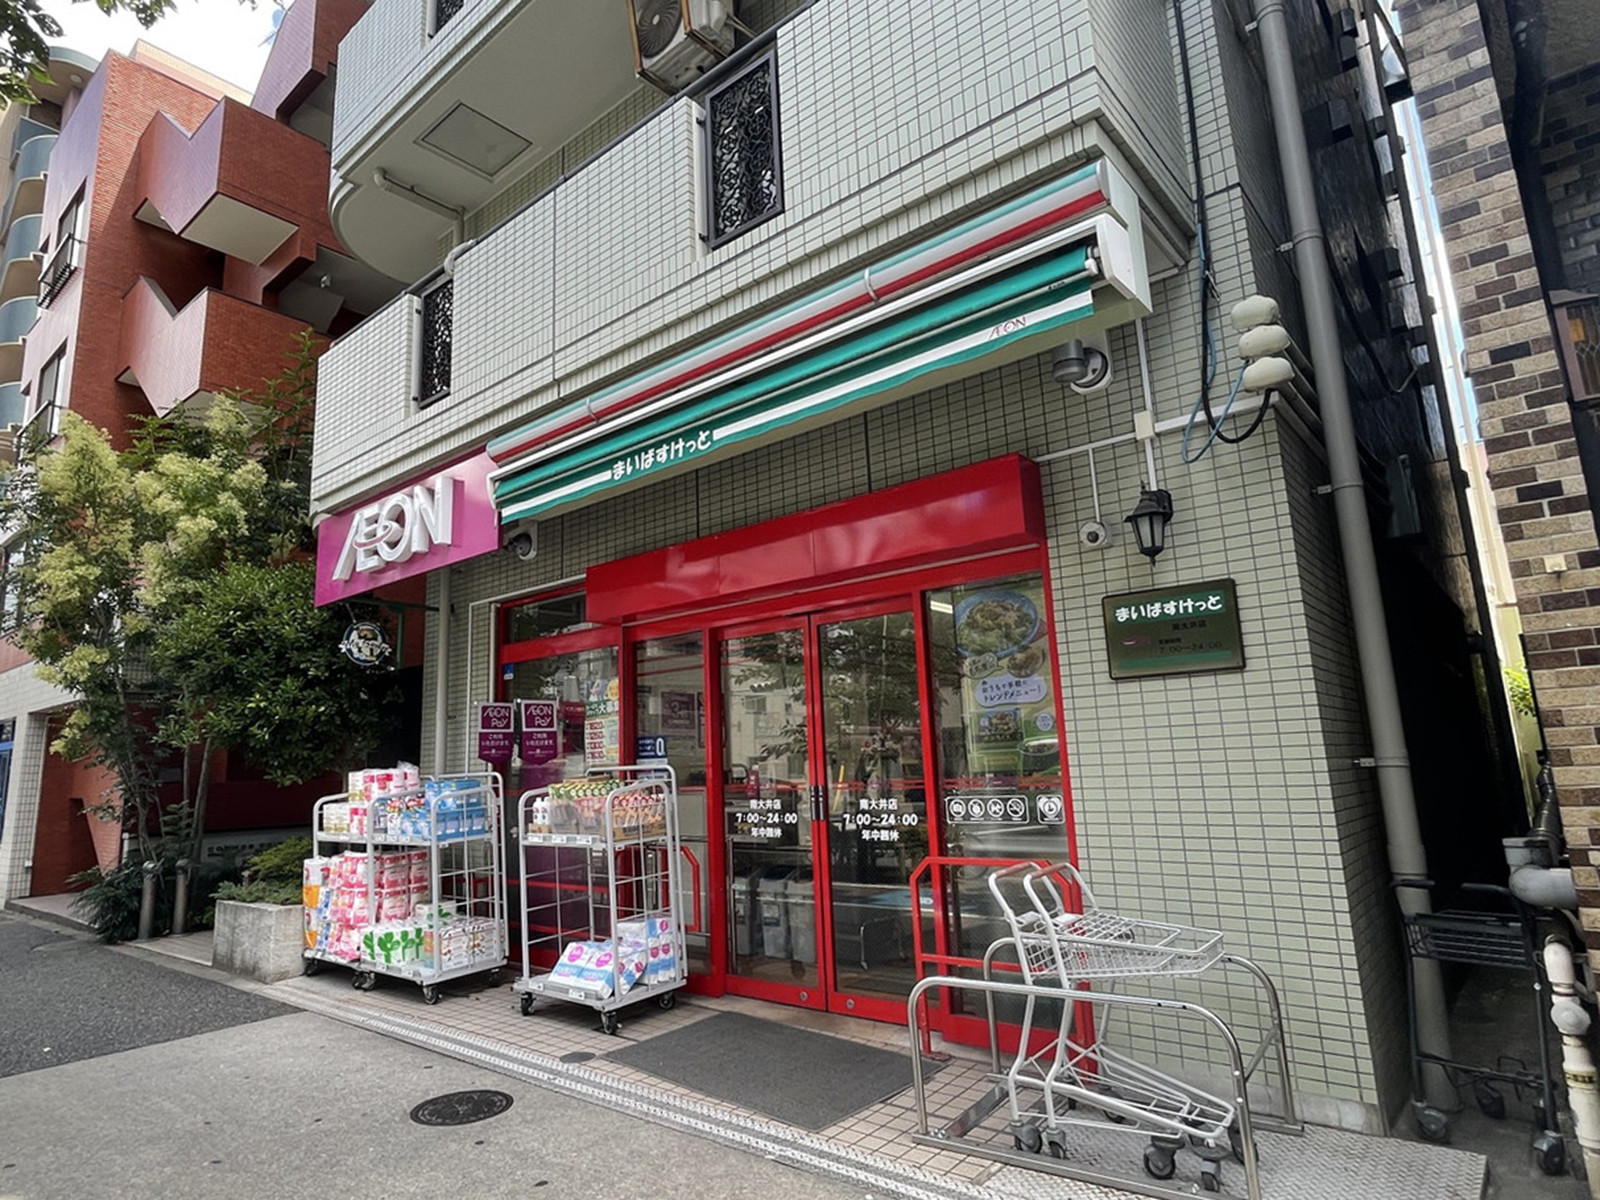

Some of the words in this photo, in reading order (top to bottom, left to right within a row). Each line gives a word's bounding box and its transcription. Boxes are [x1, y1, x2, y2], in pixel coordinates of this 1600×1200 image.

[612, 430, 711, 481] まいばすけっと
[1115, 595, 1223, 622] まいばすけっと
[750, 799, 782, 810] 南大井店
[859, 799, 898, 811] 南大井店
[751, 828, 782, 838] 年中無休
[861, 829, 899, 842] 年中無休
